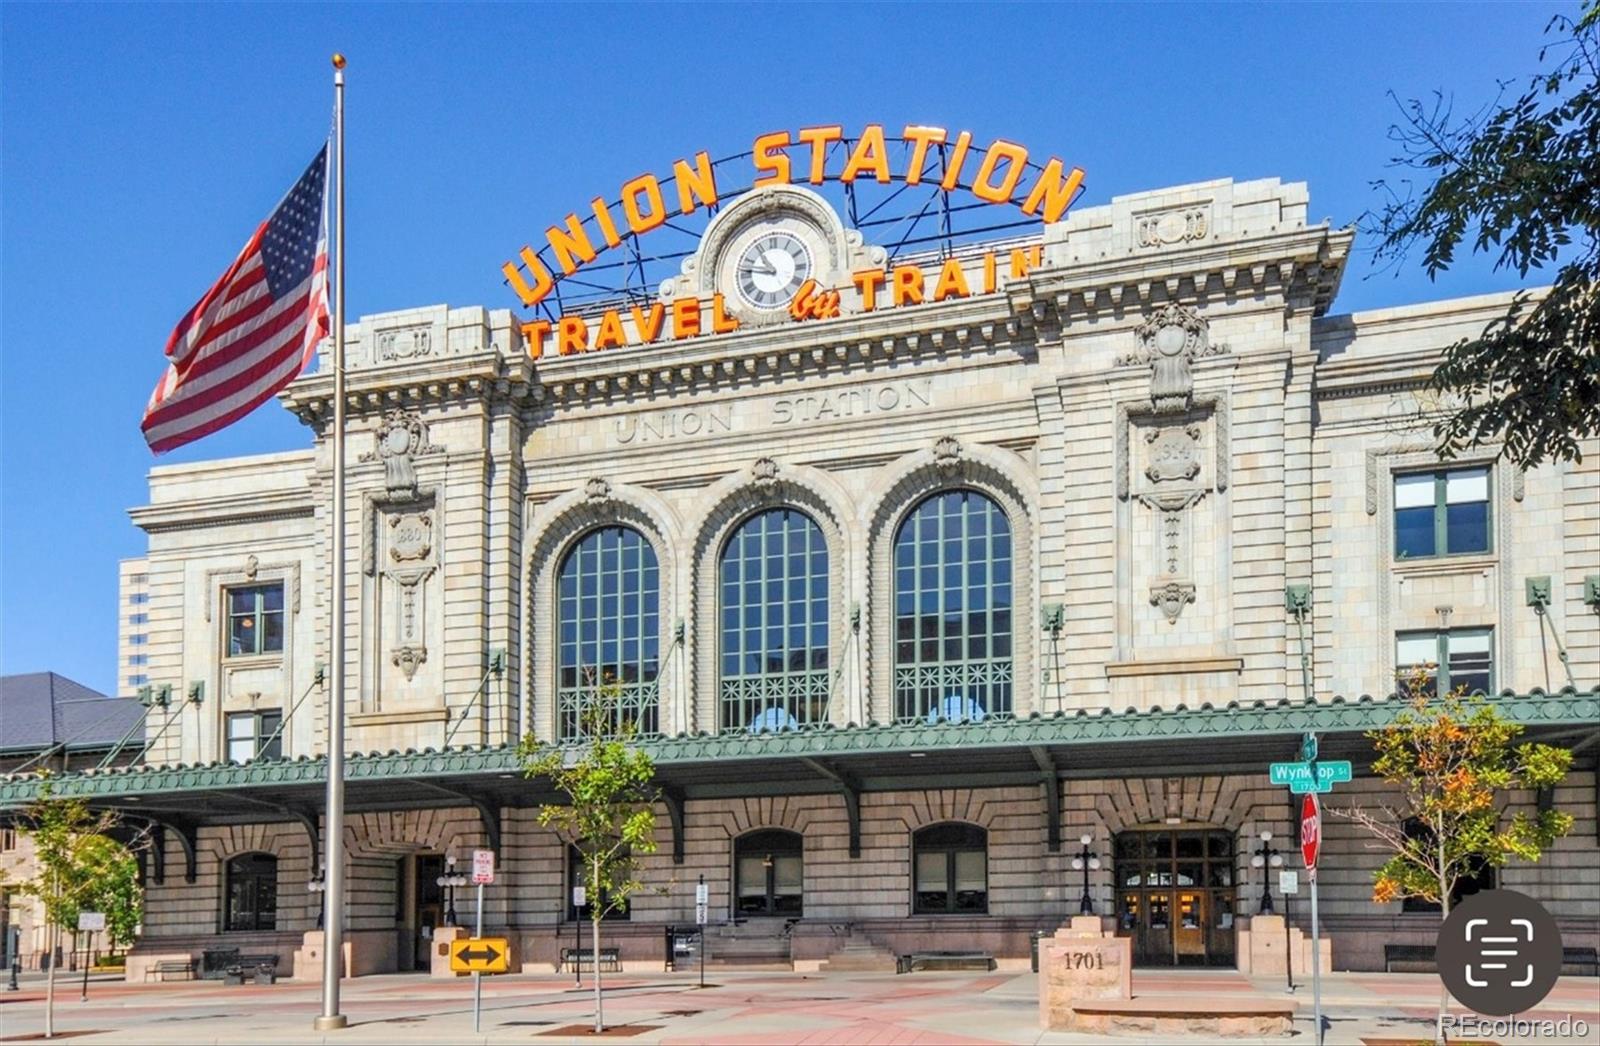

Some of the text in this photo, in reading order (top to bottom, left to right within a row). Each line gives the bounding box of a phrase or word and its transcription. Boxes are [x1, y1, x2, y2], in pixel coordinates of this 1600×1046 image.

[502, 124, 1085, 307] UNION STATION
[521, 245, 1043, 358] TRAVEL by TRAIN
[615, 378, 932, 444] UNION STATION
[1275, 766, 1334, 780] Wynkop
[1302, 815, 1317, 846] STOP
[1064, 952, 1104, 970] 1701
